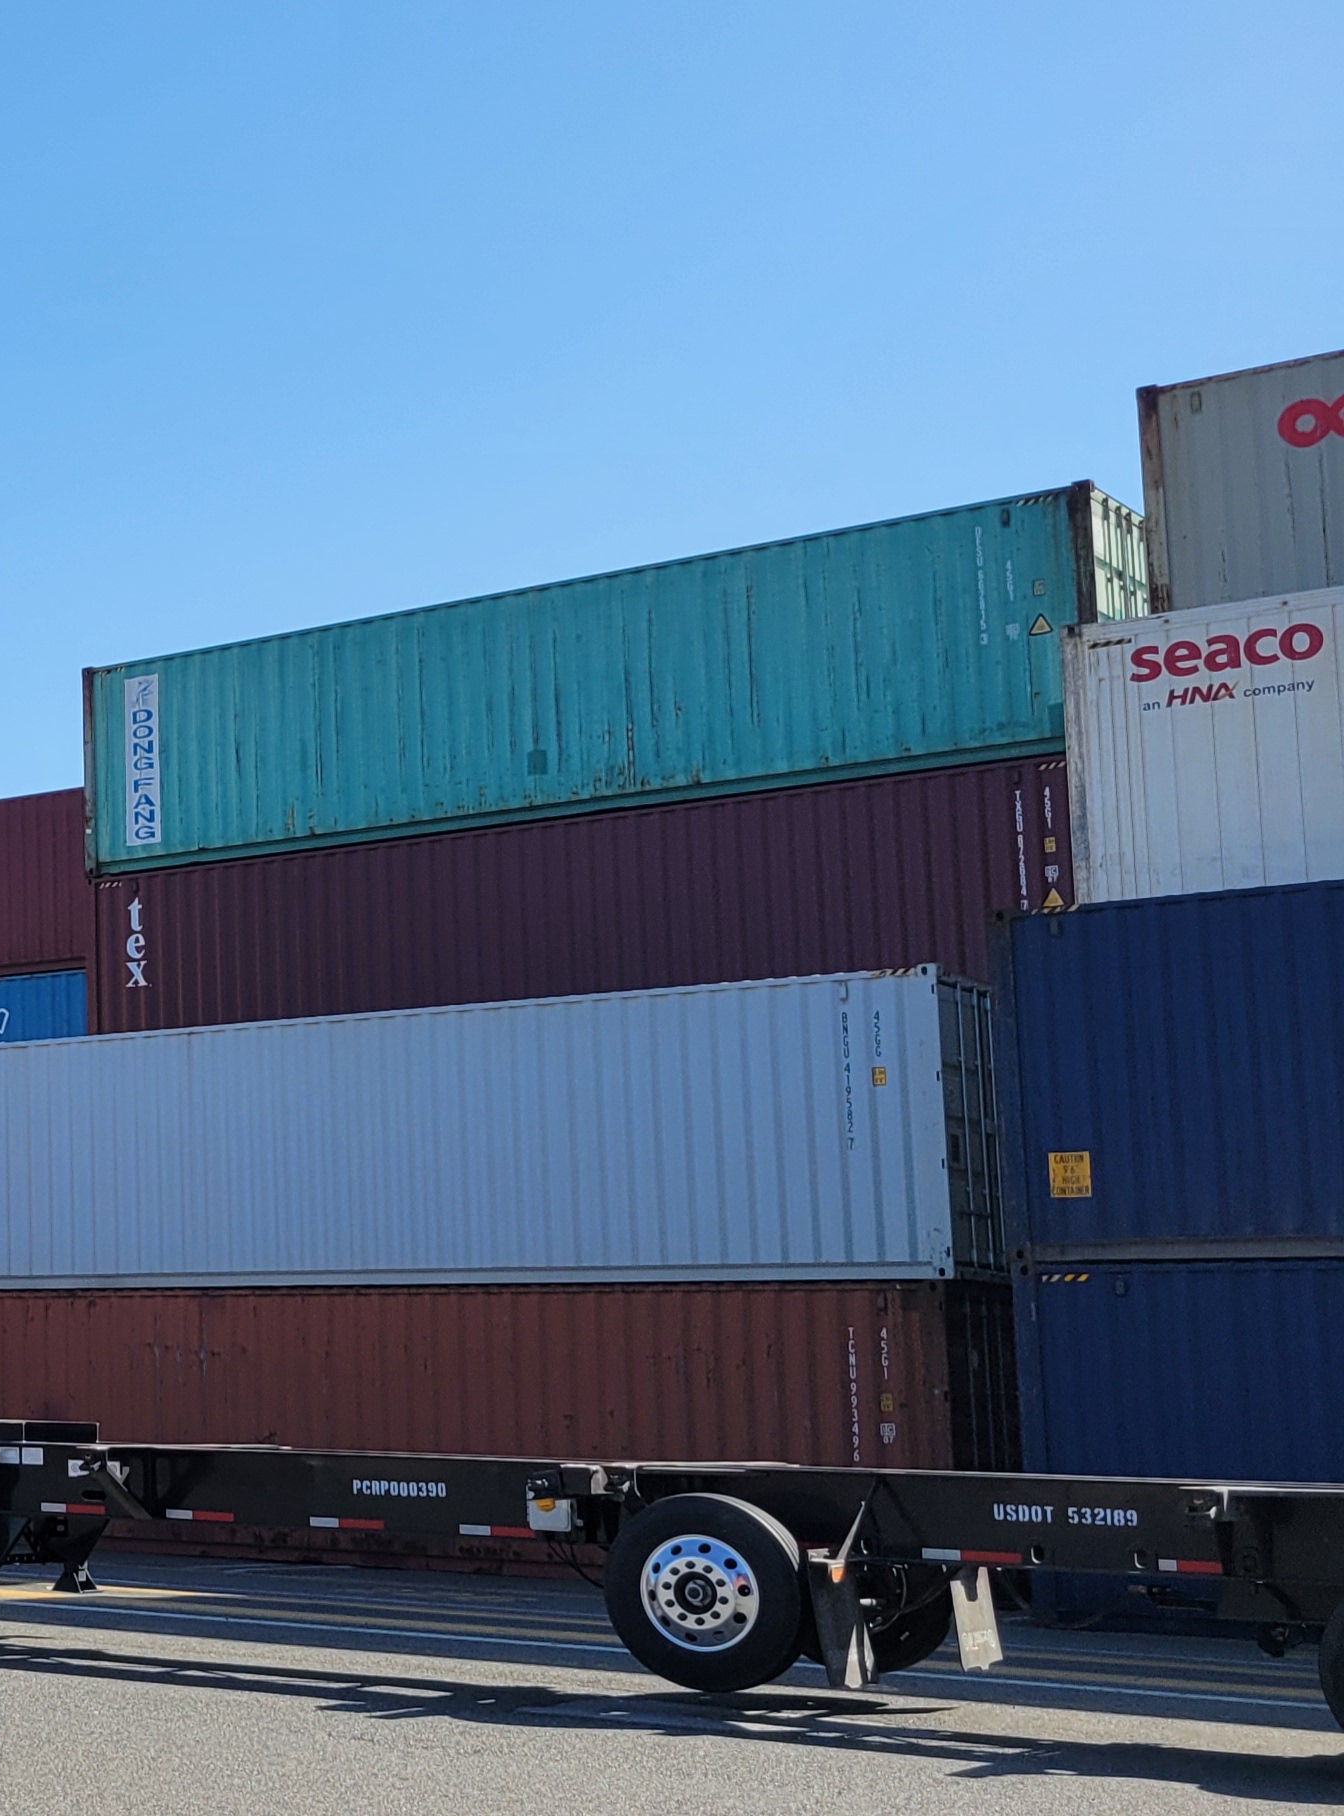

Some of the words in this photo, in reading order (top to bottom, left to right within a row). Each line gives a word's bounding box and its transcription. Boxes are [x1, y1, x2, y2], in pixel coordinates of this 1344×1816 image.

[1277, 393, 1344, 448] O
[1129, 622, 1324, 683] seaco
[1142, 700, 1161, 711] an
[1243, 679, 1315, 699] company
[132, 709, 154, 771] DONG
[132, 777, 156, 840] FANG
[843, 1062, 854, 1133] 419582
[848, 1137, 854, 1150] 7
[848, 1326, 857, 1379] TCNU
[880, 1326, 889, 1380] 45G1
[850, 1381, 860, 1462] 993496
[352, 1479, 447, 1498] PCRP000390
[993, 1503, 1054, 1524] USDOT
[1067, 1506, 1138, 1527] 532189
